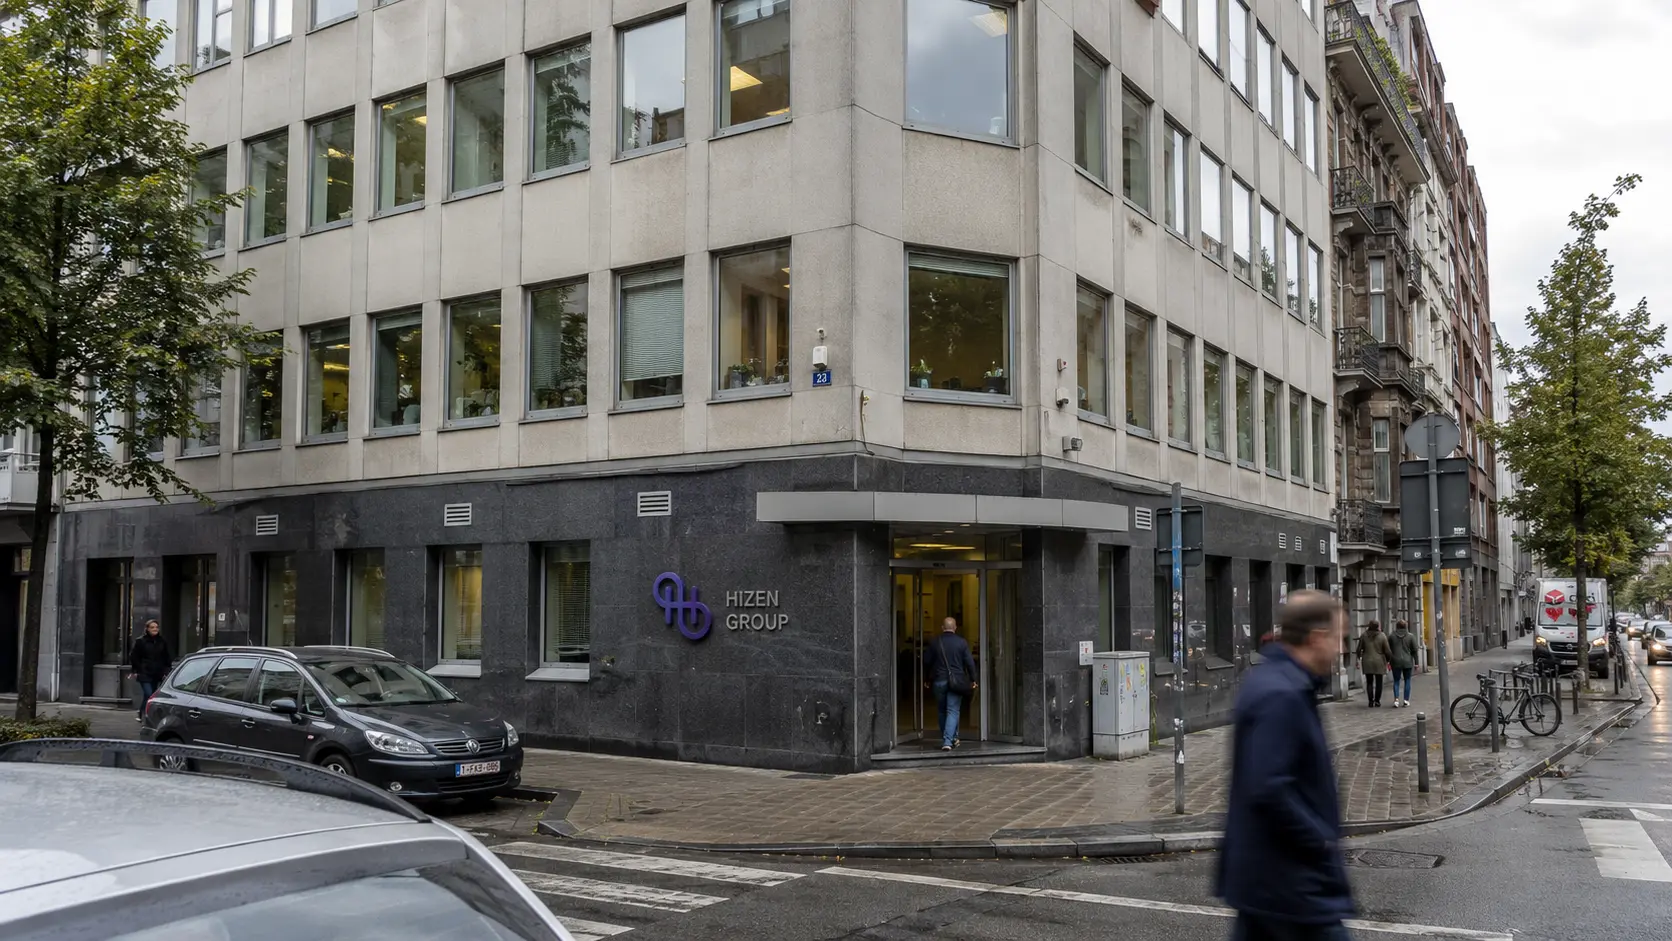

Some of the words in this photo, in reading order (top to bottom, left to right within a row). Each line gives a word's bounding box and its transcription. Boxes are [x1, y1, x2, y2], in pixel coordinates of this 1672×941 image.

[816, 373, 827, 383] 23
[726, 590, 779, 607] HIZEN
[726, 613, 789, 630] GROUP
